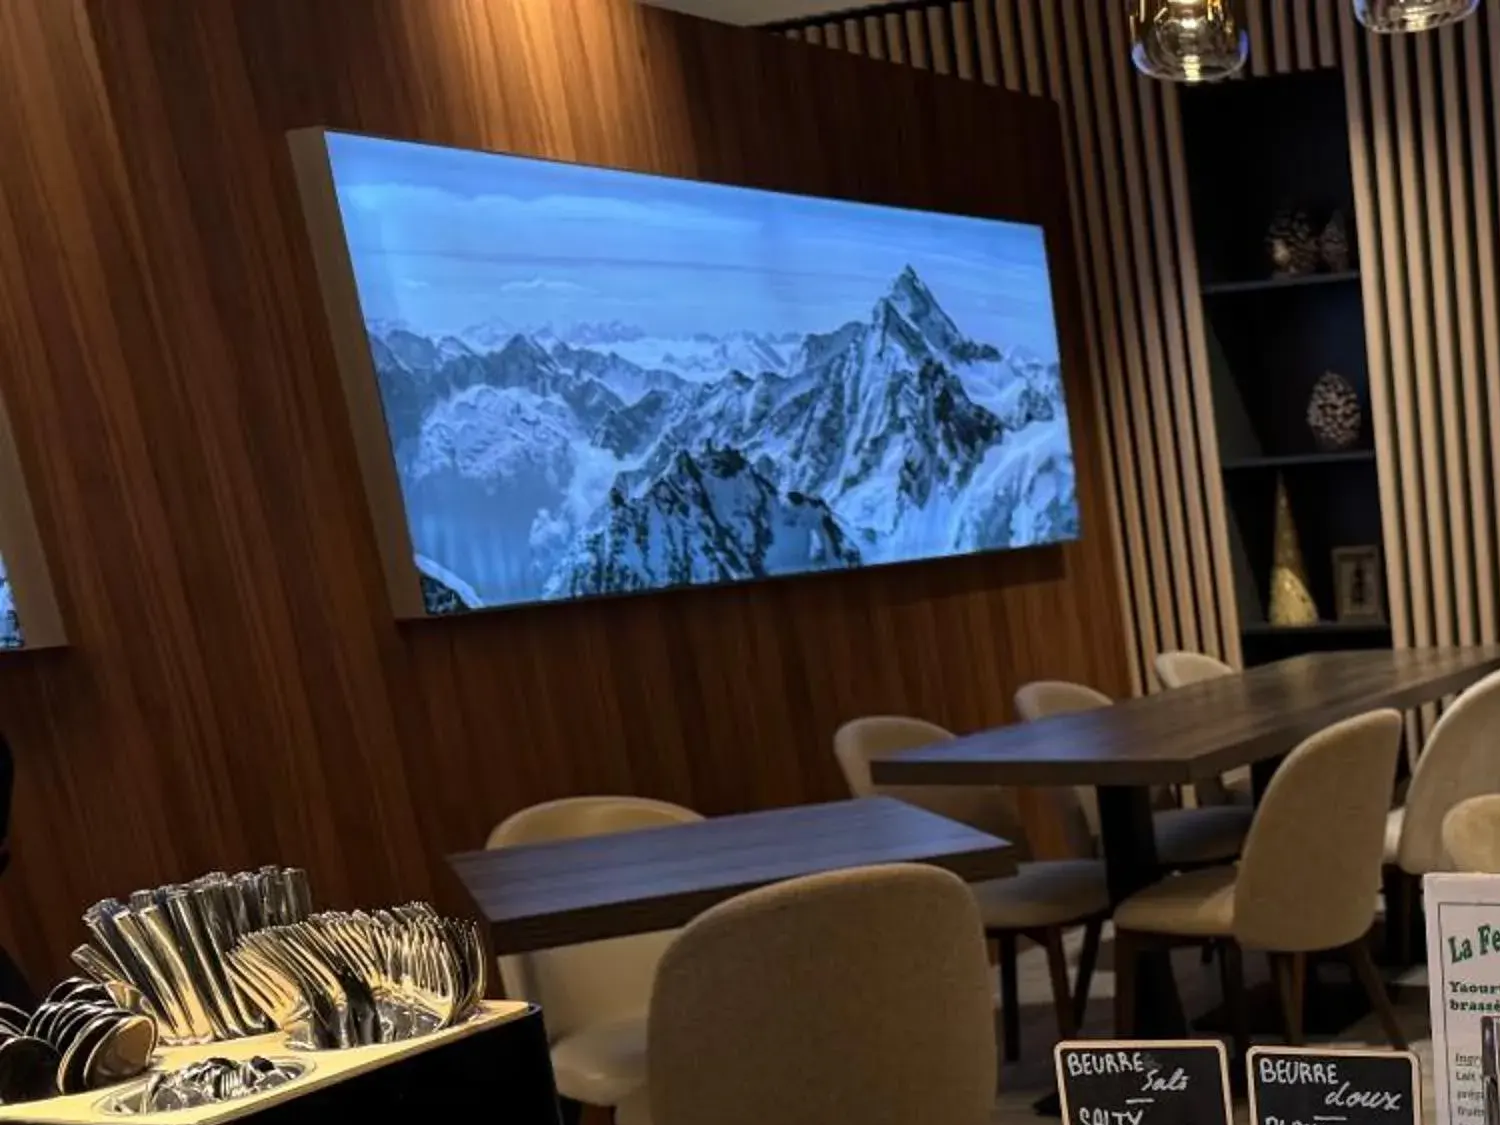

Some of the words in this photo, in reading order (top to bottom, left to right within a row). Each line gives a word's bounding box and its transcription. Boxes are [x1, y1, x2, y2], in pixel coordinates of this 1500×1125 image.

[1448, 936, 1473, 963] La
[1067, 1052, 1145, 1076] BEURRE
[1260, 1057, 1339, 1084] BEURRE
